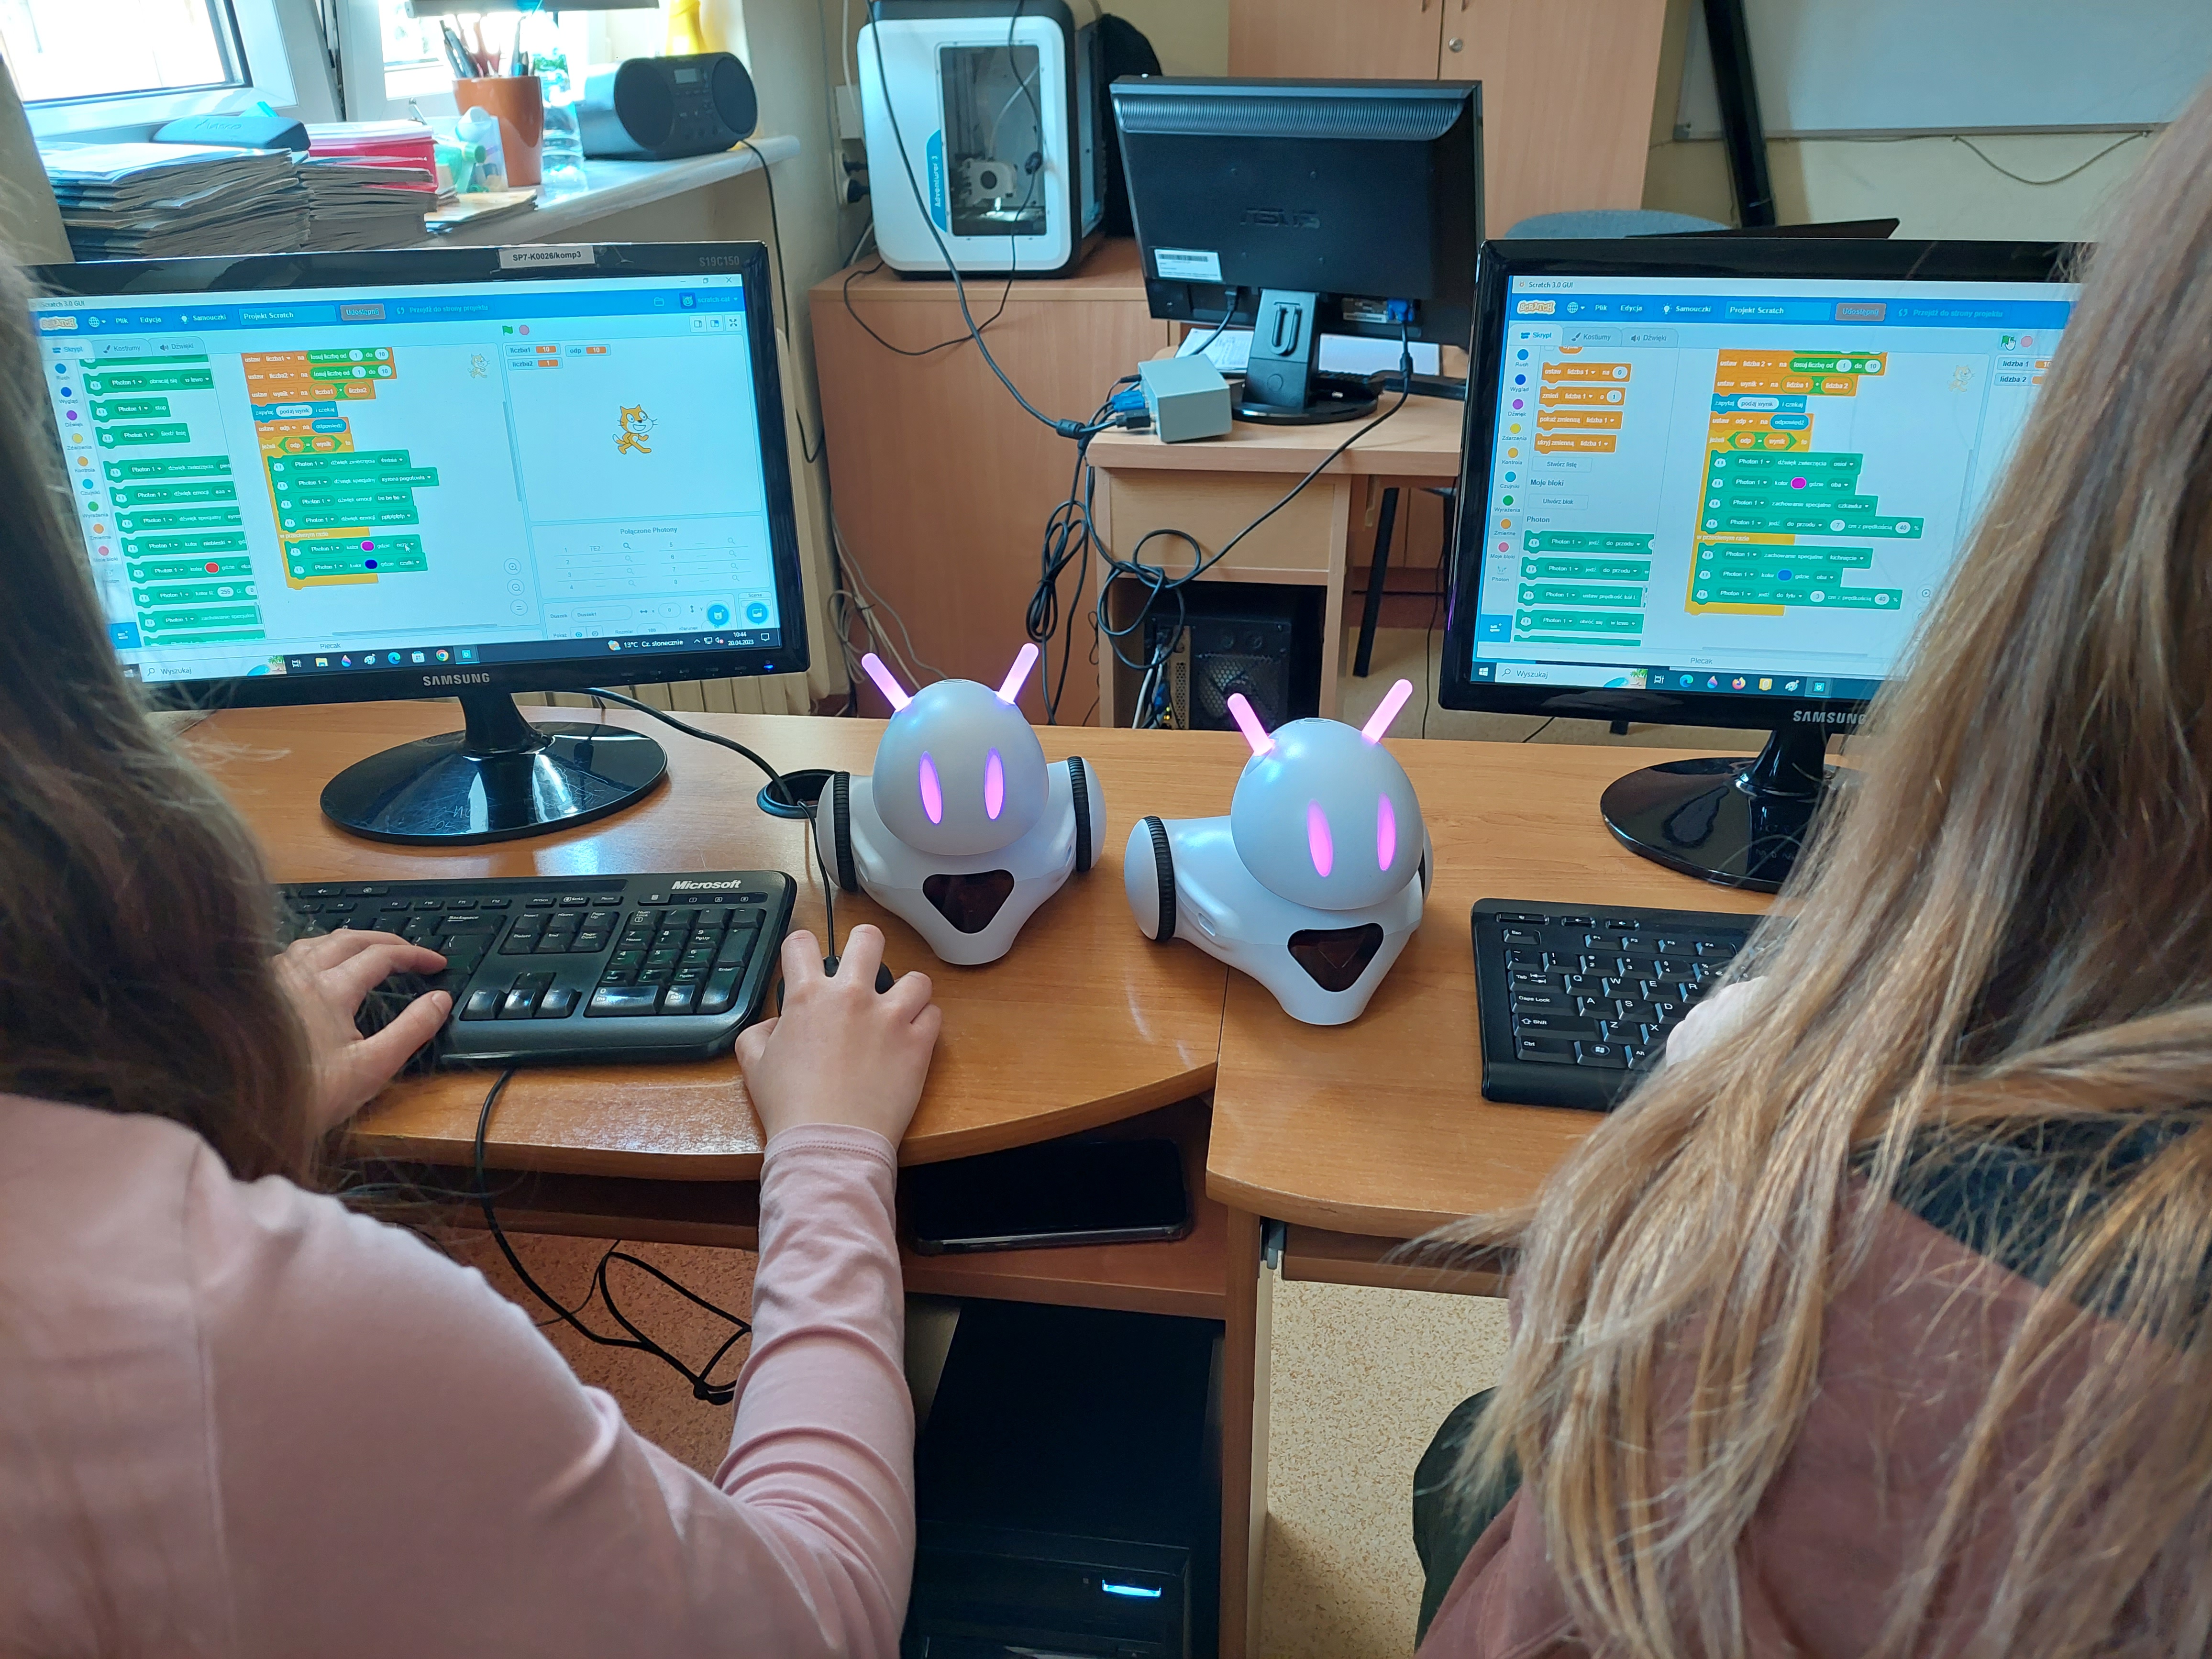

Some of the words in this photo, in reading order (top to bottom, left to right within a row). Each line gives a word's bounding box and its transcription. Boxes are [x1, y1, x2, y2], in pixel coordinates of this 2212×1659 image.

[513, 251, 581, 261] SP7-K0026/komp3
[699, 255, 740, 267] S19C150
[1519, 302, 1553, 312] SCRATCH
[160, 667, 192, 675] Wyszukaj
[1516, 670, 1548, 679] Wyszukaj
[422, 673, 490, 686] SAMSUNG
[671, 880, 741, 890] Microsoft
